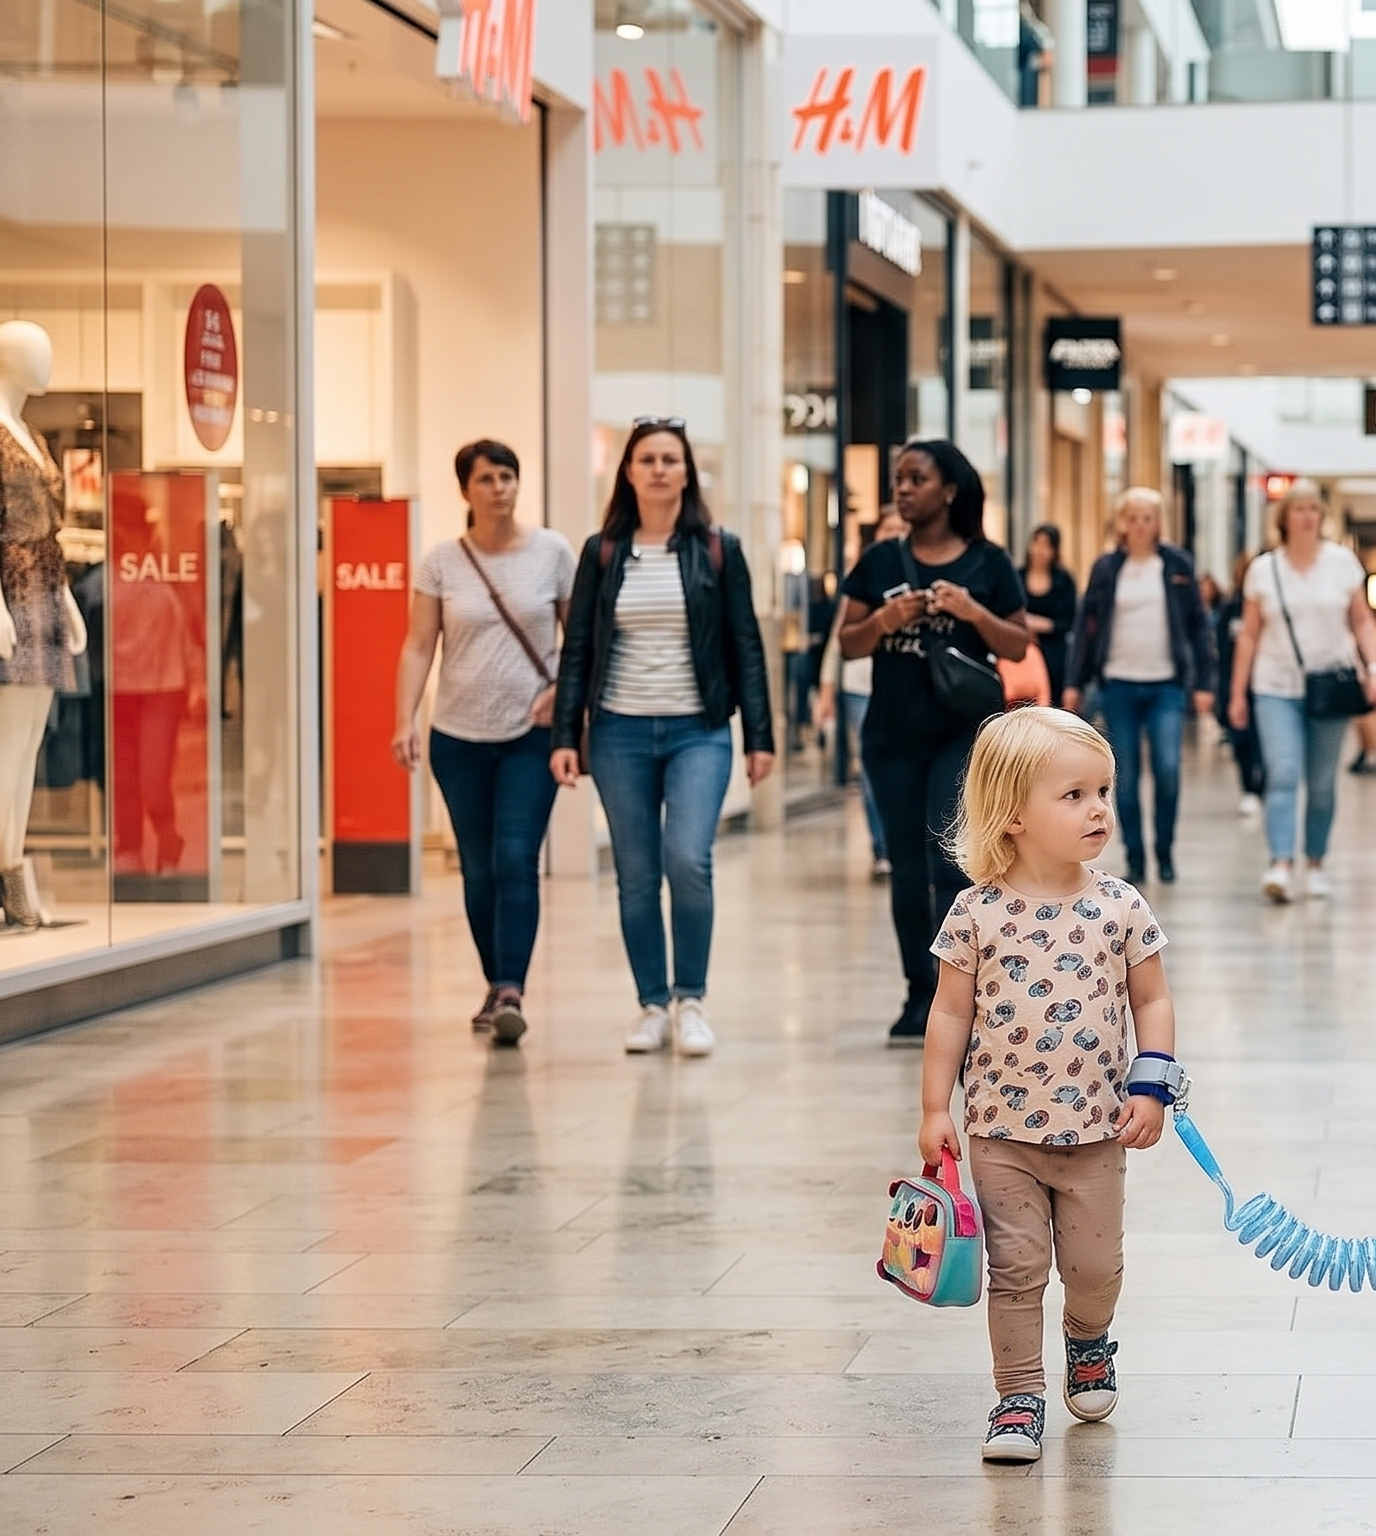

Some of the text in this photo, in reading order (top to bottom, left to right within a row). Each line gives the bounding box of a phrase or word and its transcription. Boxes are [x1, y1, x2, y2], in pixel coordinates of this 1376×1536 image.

[793, 66, 926, 156] H&M
[119, 552, 199, 583] SALE
[335, 561, 406, 591] SALE
